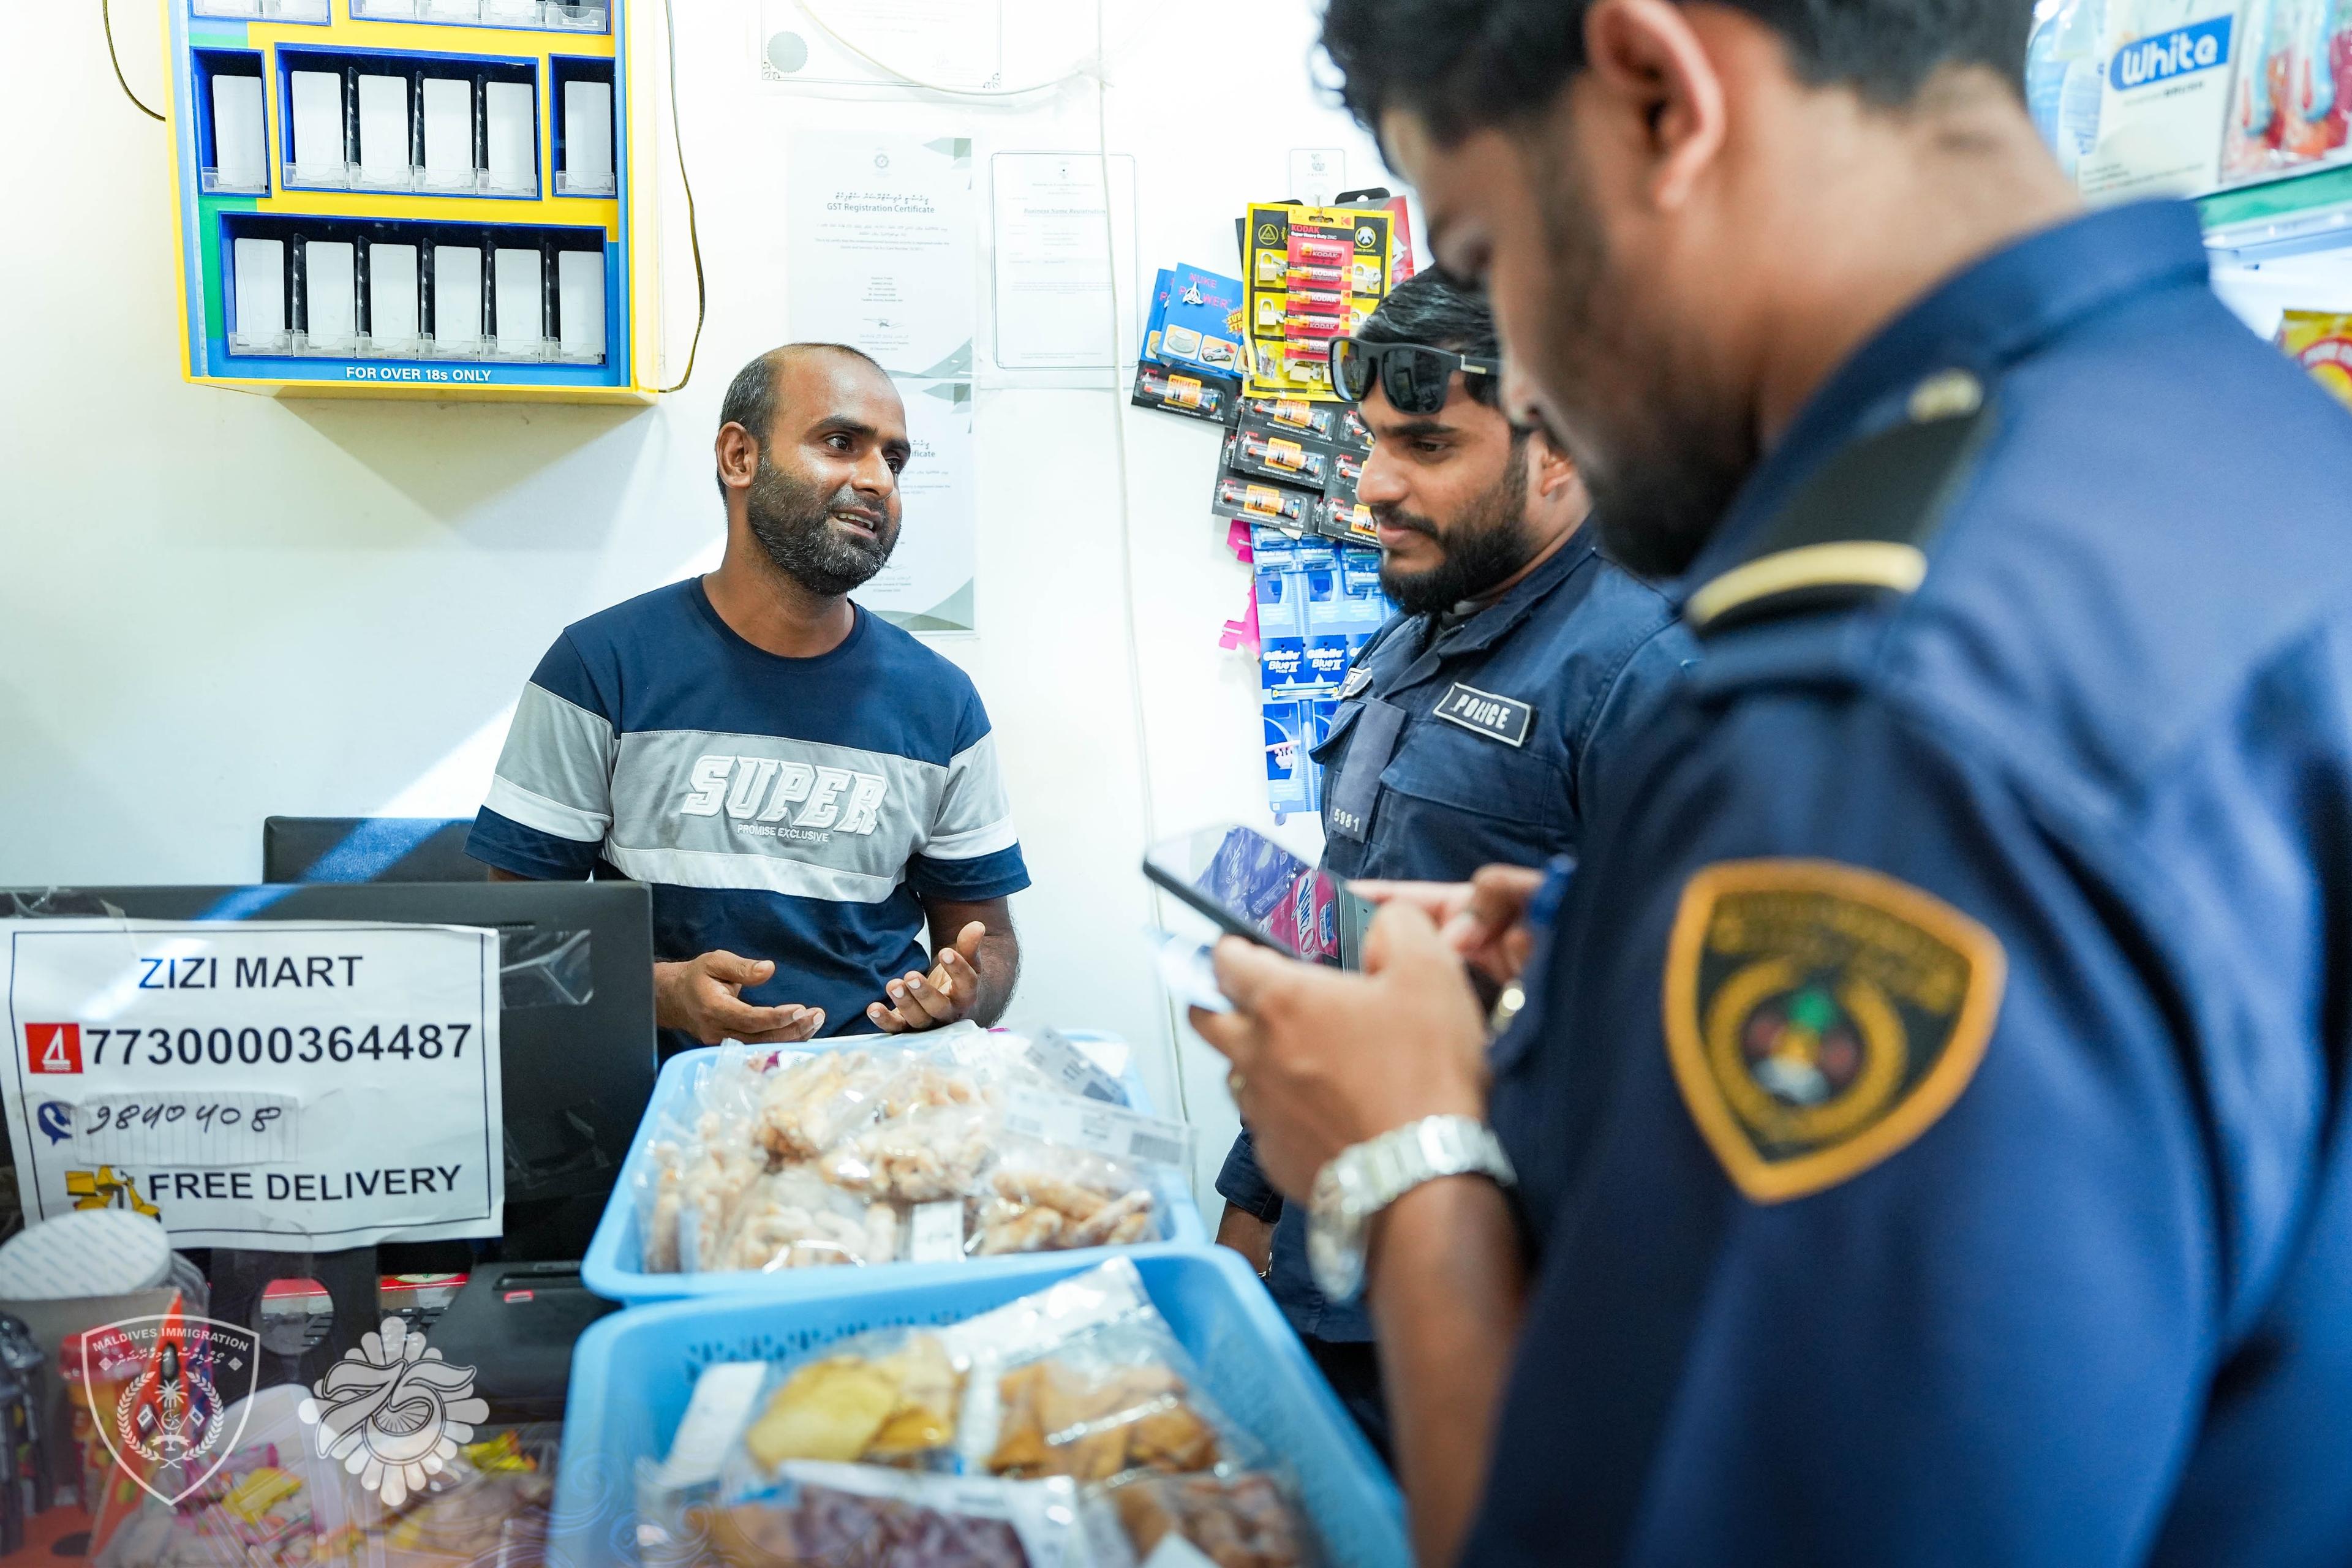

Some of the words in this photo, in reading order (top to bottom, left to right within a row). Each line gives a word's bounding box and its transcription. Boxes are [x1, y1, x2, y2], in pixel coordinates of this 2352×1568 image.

[2121, 32, 2218, 85] White
[845, 204, 892, 213] Registration
[1291, 224, 1319, 233] KODAK
[1189, 273, 1216, 288] NUKE
[1227, 311, 1243, 324] SUP
[346, 367, 377, 379] FOR
[380, 368, 421, 379] OVER
[426, 369, 448, 380] 18s
[453, 370, 491, 381] ONLY
[1262, 650, 1301, 661] Gillette
[1306, 648, 1344, 659] Gillette
[1268, 661, 1289, 670] Blue
[1312, 659, 1333, 668] Blue
[1450, 693, 1511, 729] POLICE
[680, 755, 888, 836] SUPER
[737, 824, 776, 836] PROMISE
[778, 827, 828, 842] EXCLUSIVE
[138, 957, 216, 989] ZIZI
[236, 955, 364, 988] MART
[86, 1023, 473, 1065] 7730000364487
[149, 1173, 254, 1200] FREE
[267, 1165, 462, 1201] DELIVERY
